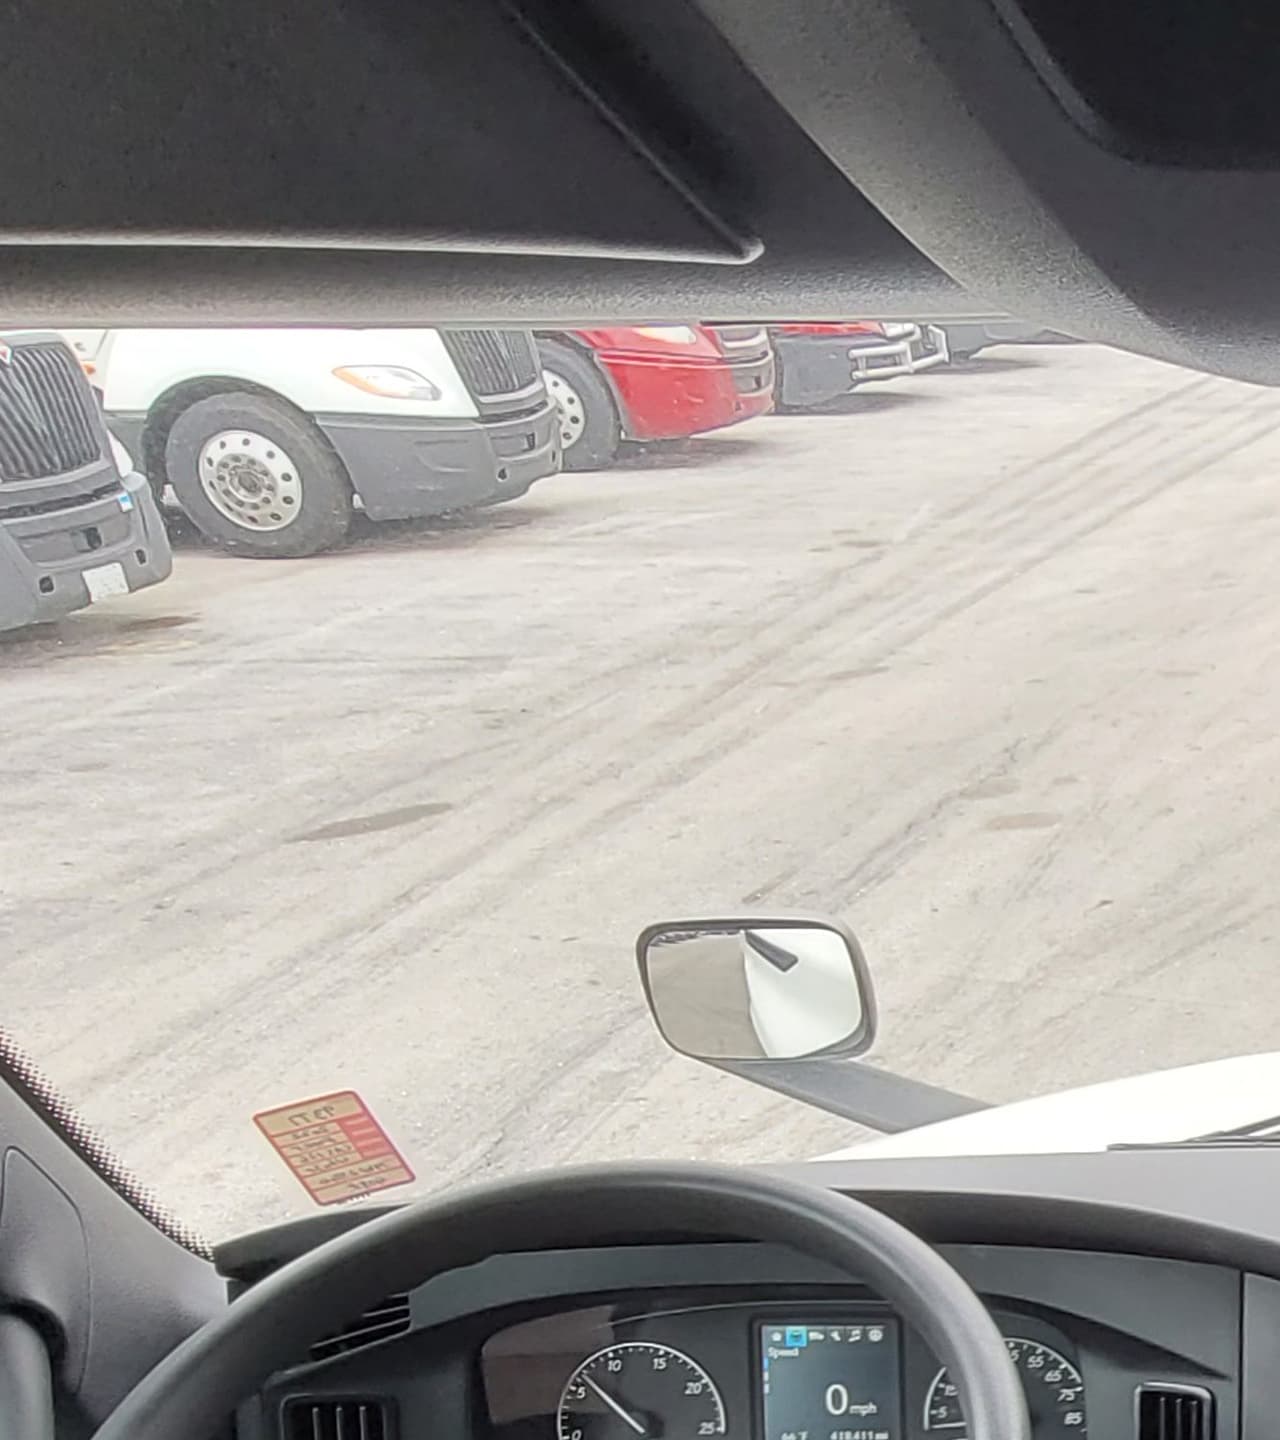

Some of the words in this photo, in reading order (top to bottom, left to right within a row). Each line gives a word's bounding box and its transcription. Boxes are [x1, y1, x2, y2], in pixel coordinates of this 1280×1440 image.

[607, 1359, 622, 1372] 10
[652, 1357, 667, 1370] 15
[1027, 1355, 1044, 1368] 55
[1044, 1370, 1062, 1382] 65
[576, 1386, 586, 1399] 5
[684, 1382, 702, 1395] 20
[826, 1383, 848, 1415] 0
[849, 1402, 878, 1416] mph
[1057, 1389, 1075, 1402] 75
[1064, 1412, 1083, 1425] 85
[697, 1422, 715, 1435] 25
